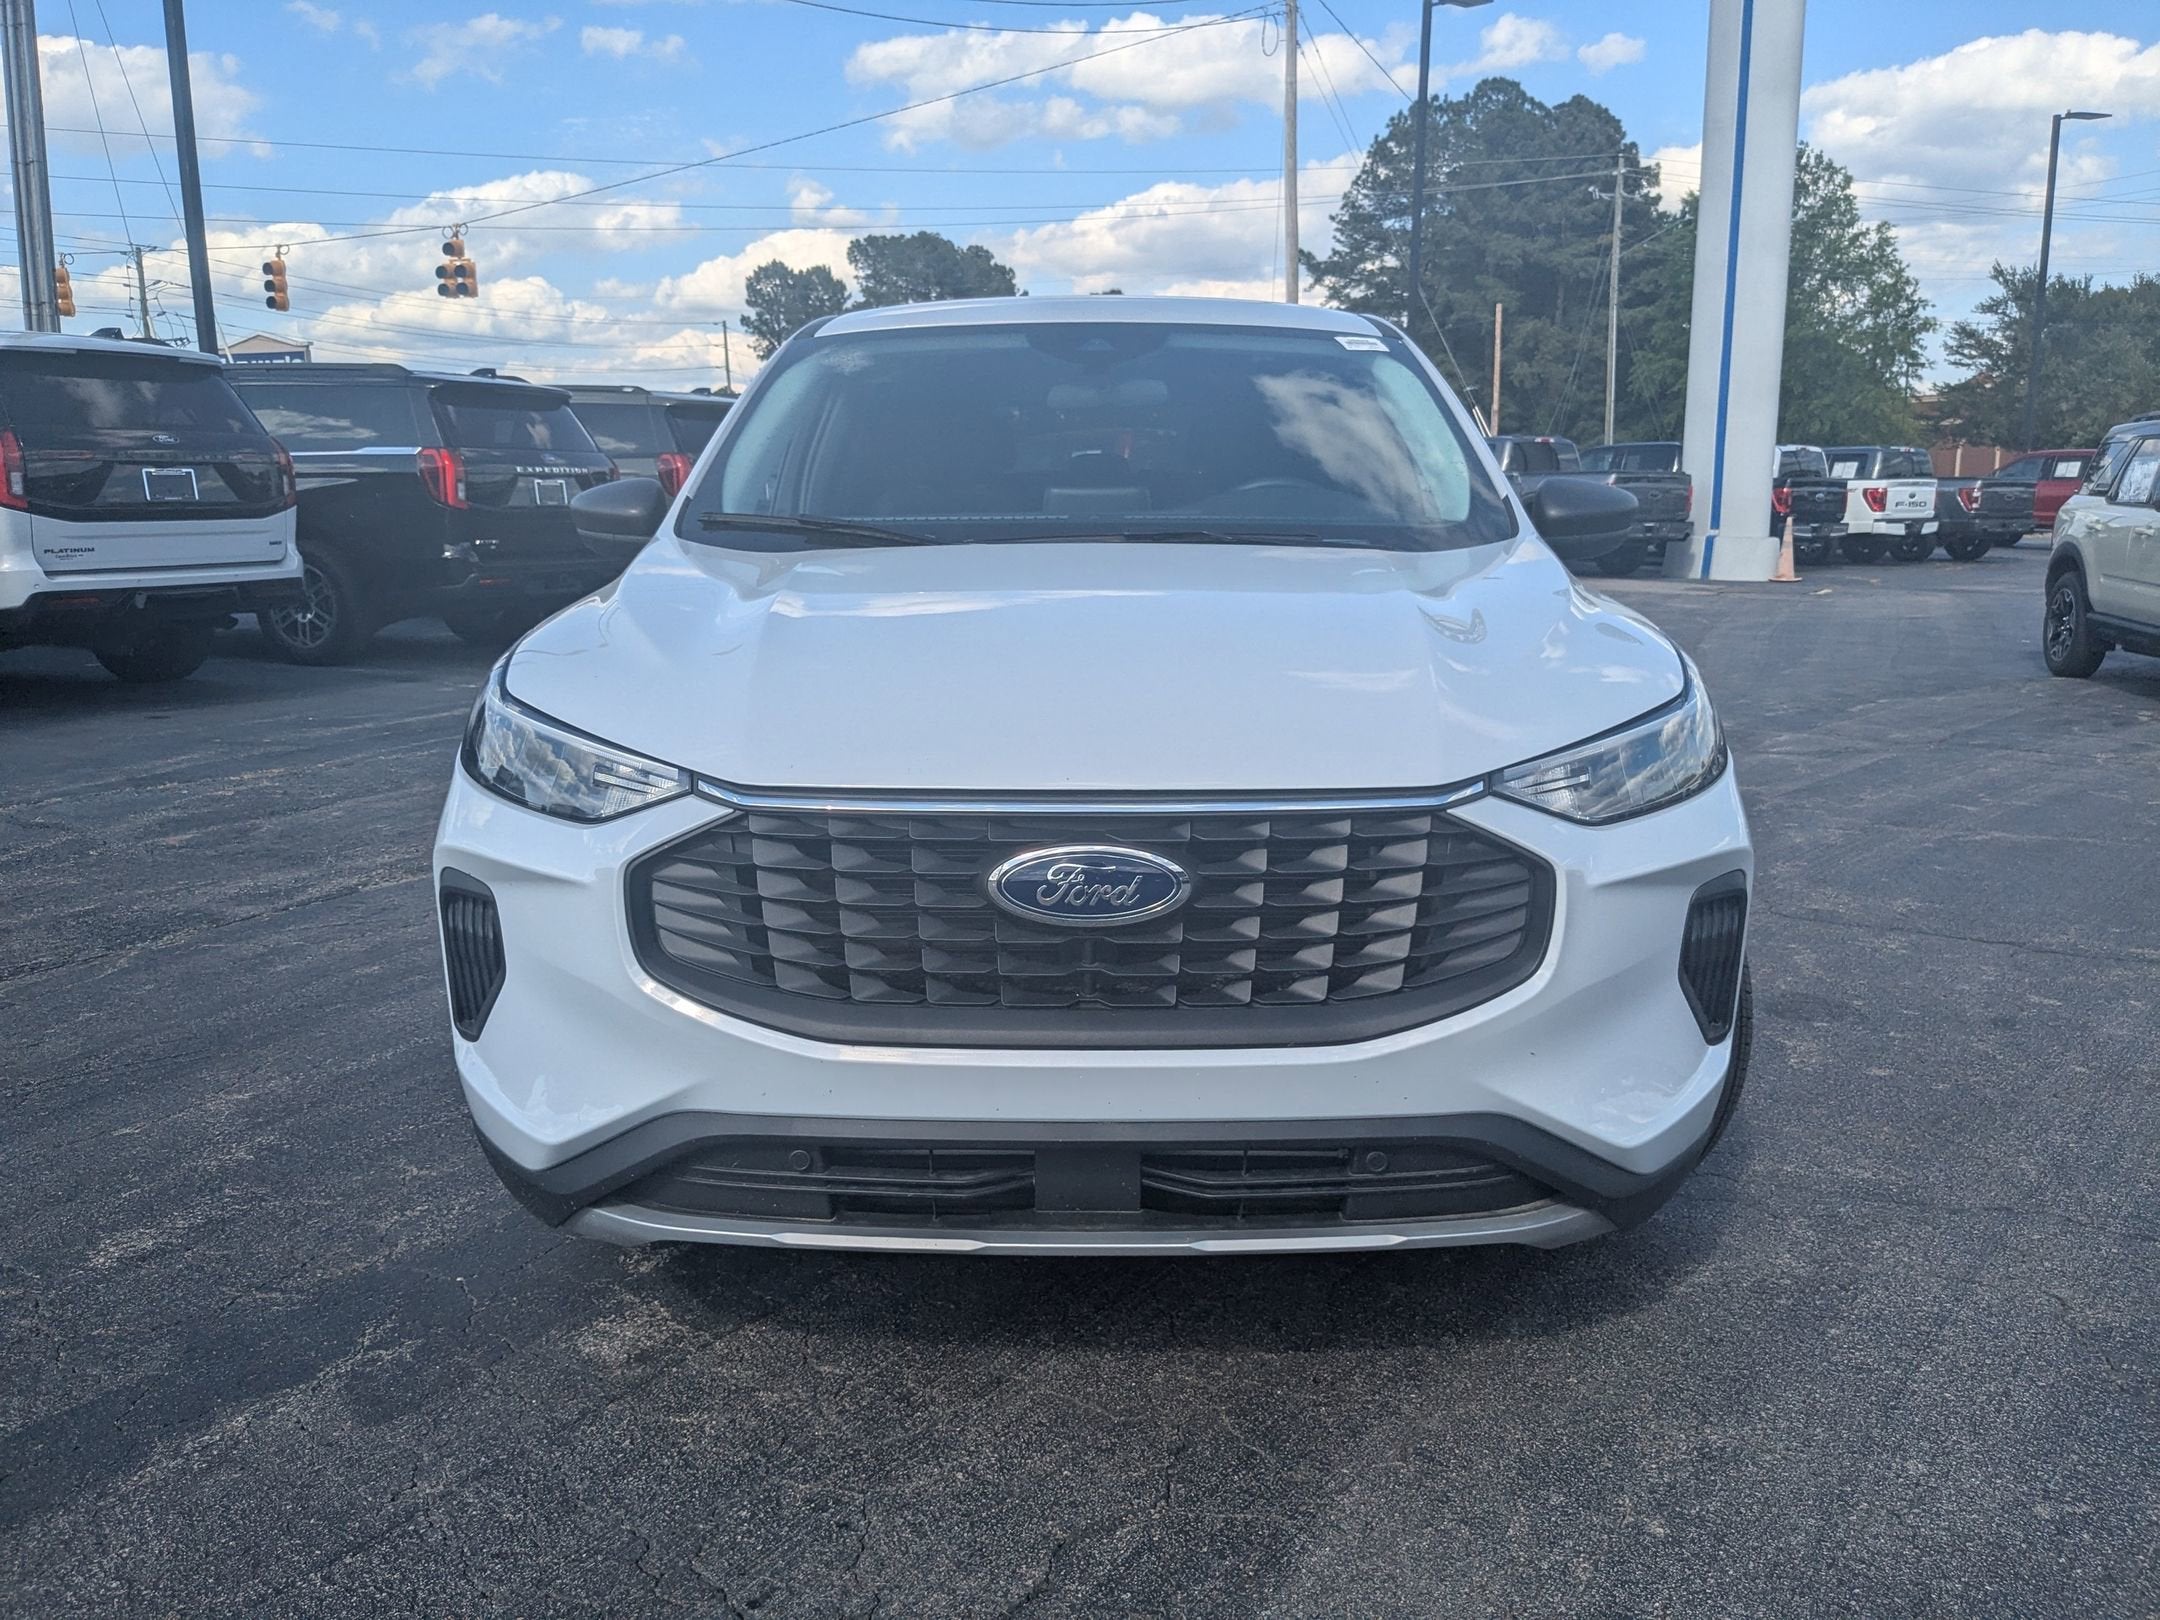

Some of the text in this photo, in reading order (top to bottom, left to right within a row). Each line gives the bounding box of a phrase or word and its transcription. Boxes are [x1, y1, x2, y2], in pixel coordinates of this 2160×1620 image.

[515, 465, 589, 474] EXPEDITION
[43, 547, 96, 555] PLATINUM
[1036, 862, 1143, 907] Ford
